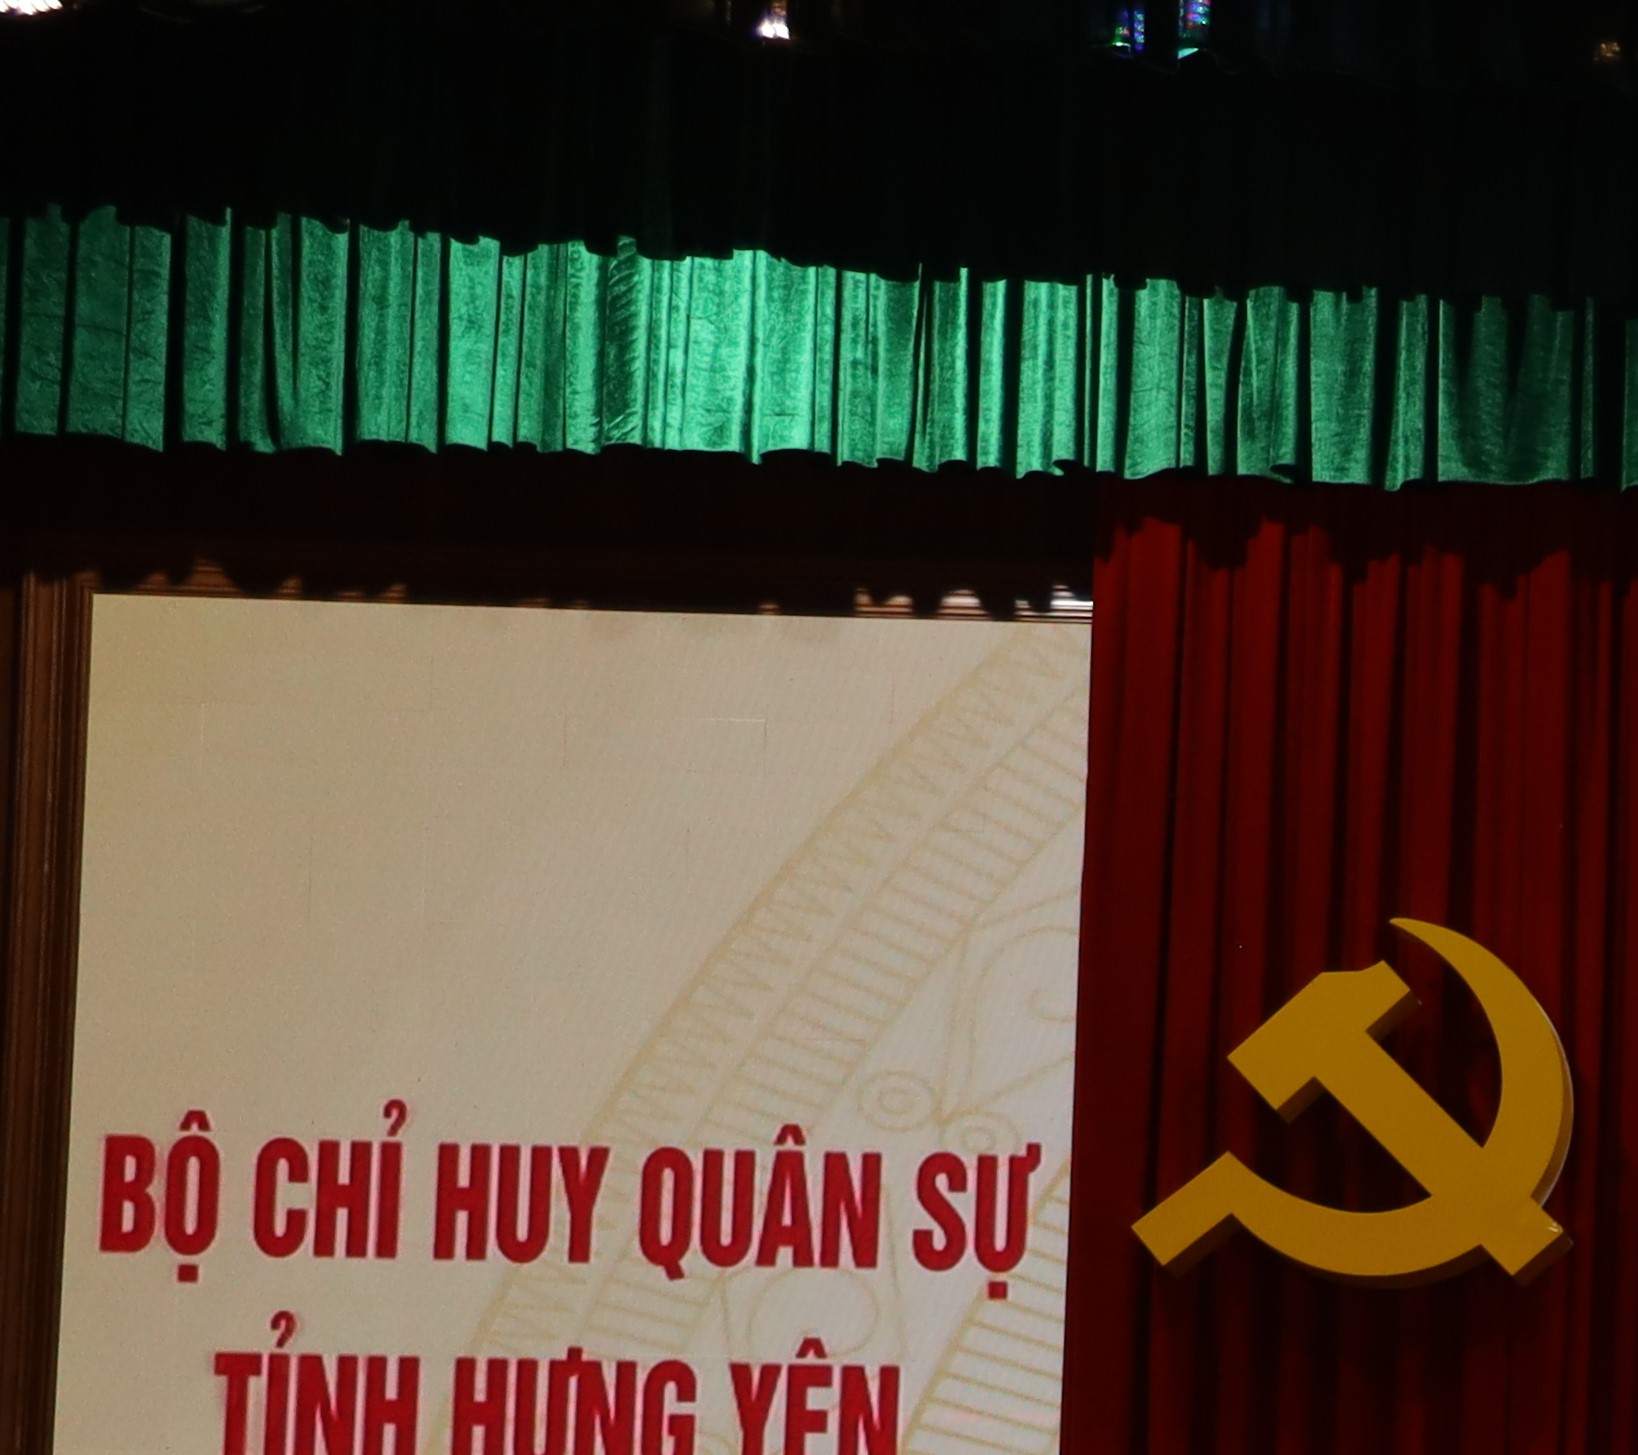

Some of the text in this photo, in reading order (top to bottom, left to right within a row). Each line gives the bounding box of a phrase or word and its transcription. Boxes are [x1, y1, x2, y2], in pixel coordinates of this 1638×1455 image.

[100, 1101, 1039, 1299] BỘ CHỈ HUY QUÂN SỰ
